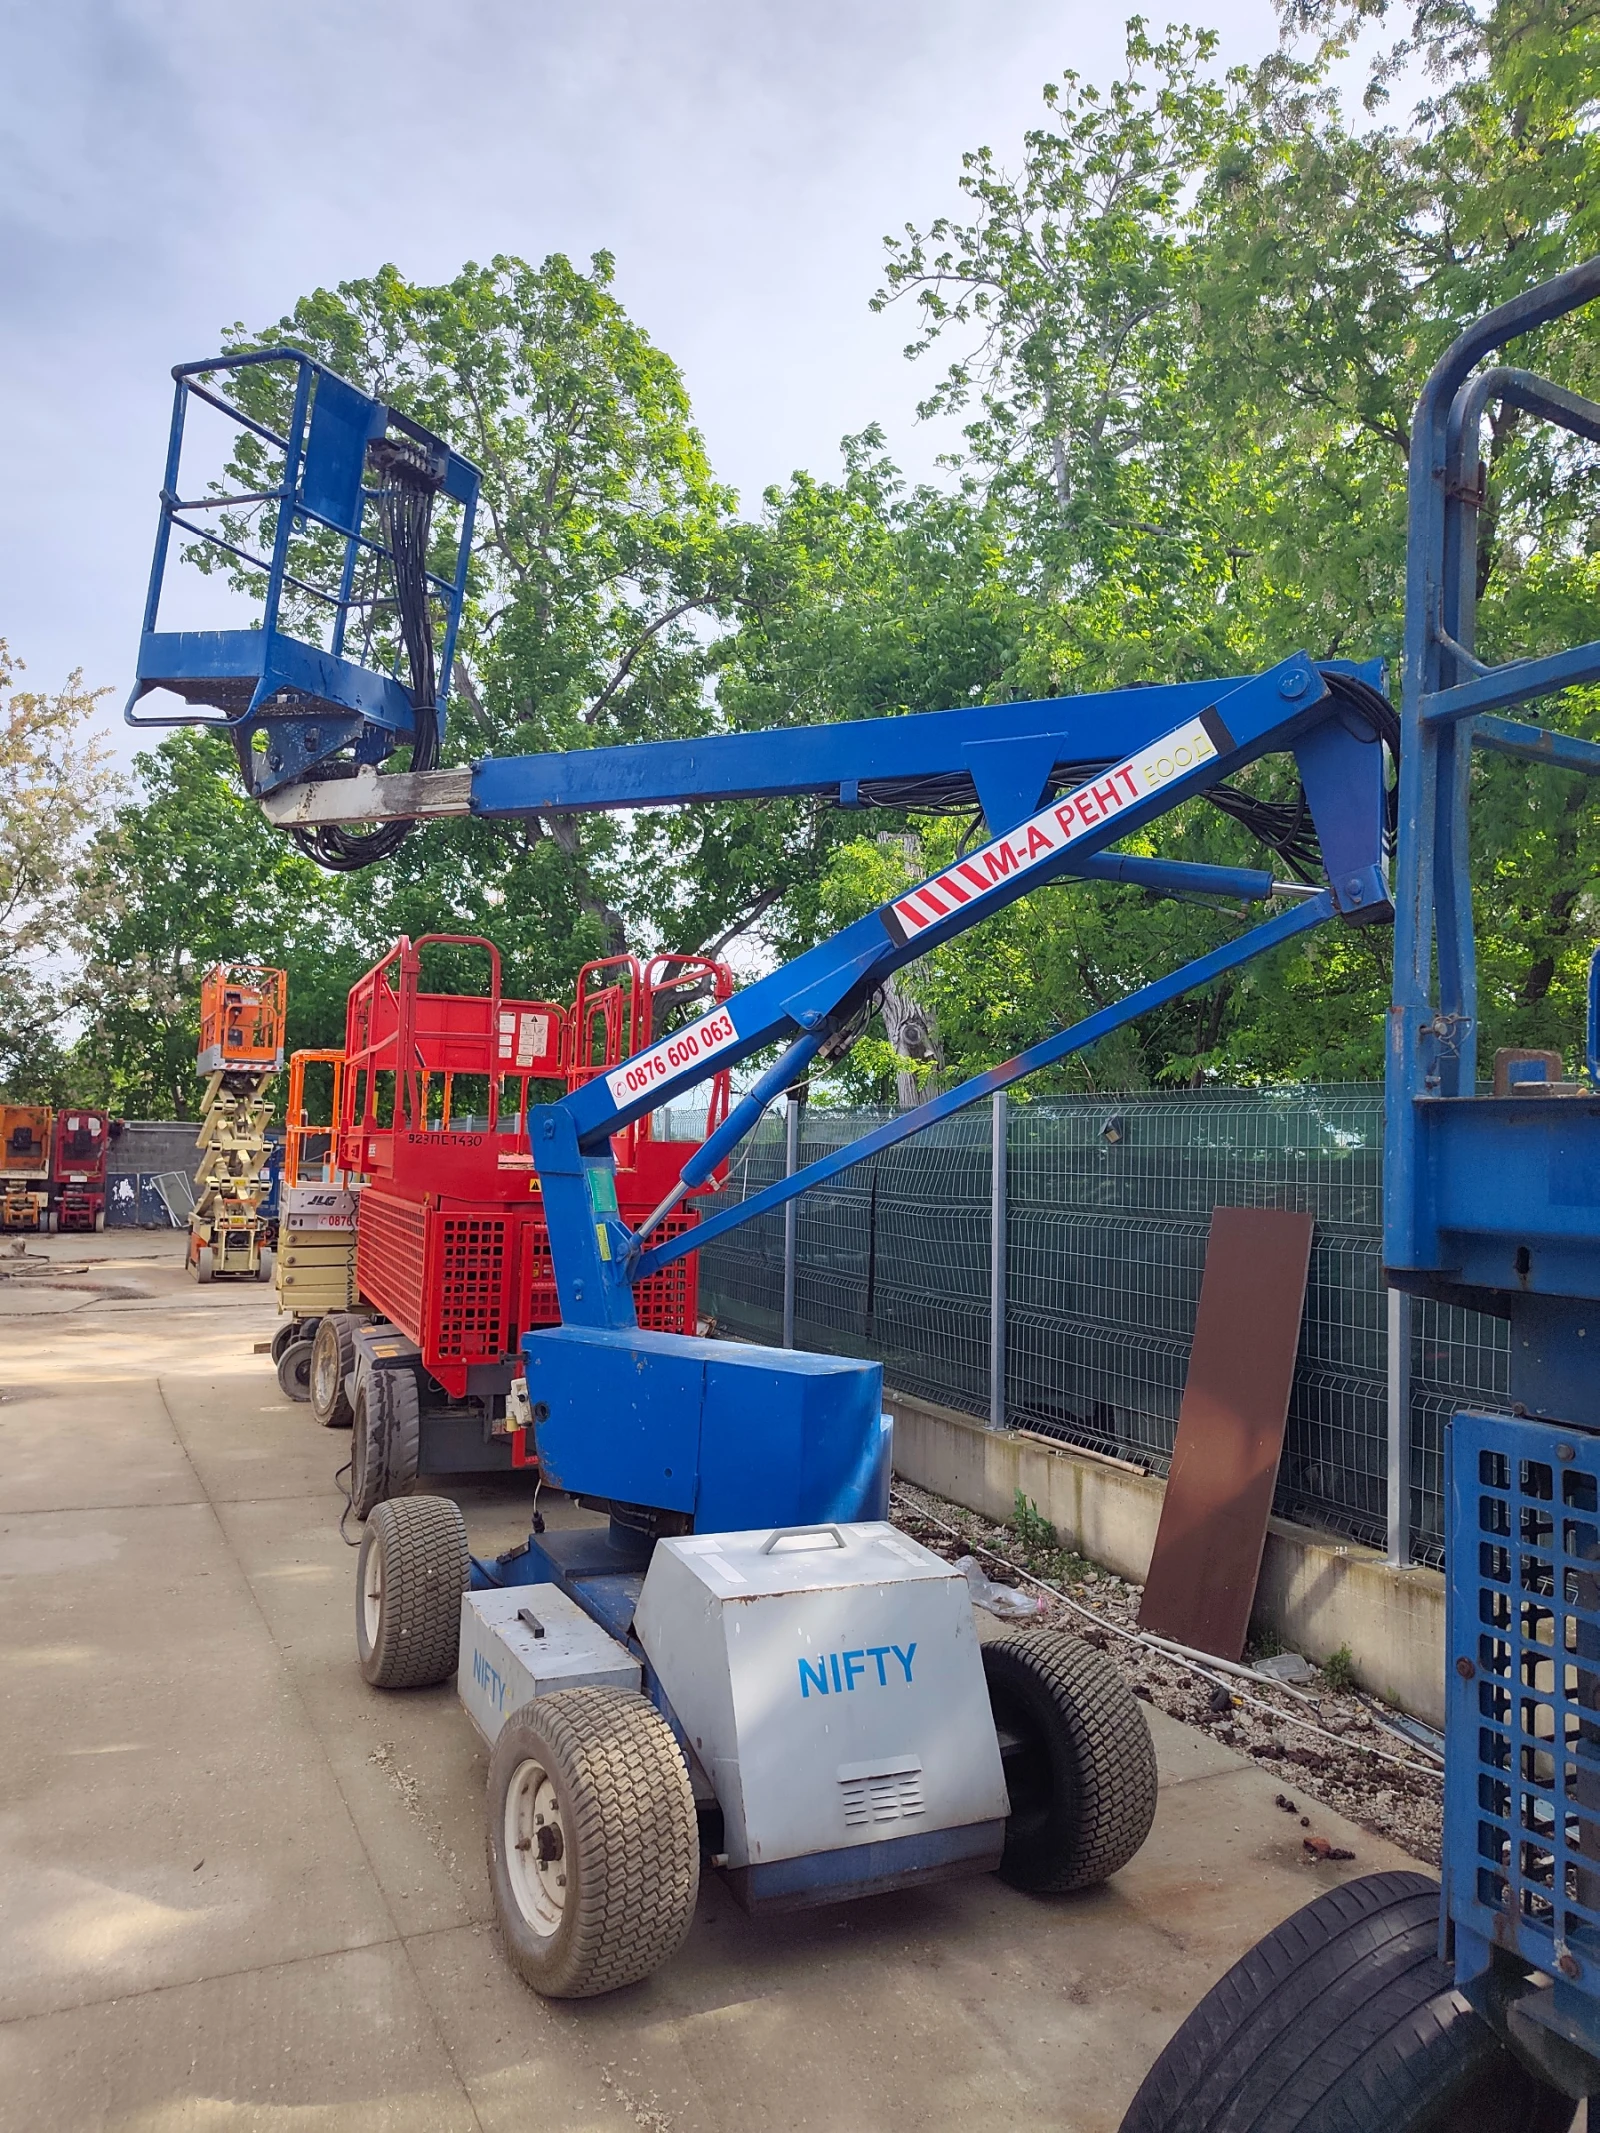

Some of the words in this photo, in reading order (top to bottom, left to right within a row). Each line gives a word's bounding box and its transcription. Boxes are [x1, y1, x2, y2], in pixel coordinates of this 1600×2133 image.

[982, 825, 1055, 882] М-А
[1054, 764, 1140, 838] РЕНТ
[1143, 734, 1215, 787] ЕООД
[625, 1055, 667, 1091] 0876
[667, 1035, 699, 1067] 600
[700, 1015, 733, 1048] 063
[307, 1195, 338, 1206] JLG
[328, 1215, 352, 1227] 0876
[473, 1648, 506, 1712] NIFTY
[798, 1642, 917, 1698] NIFTY
